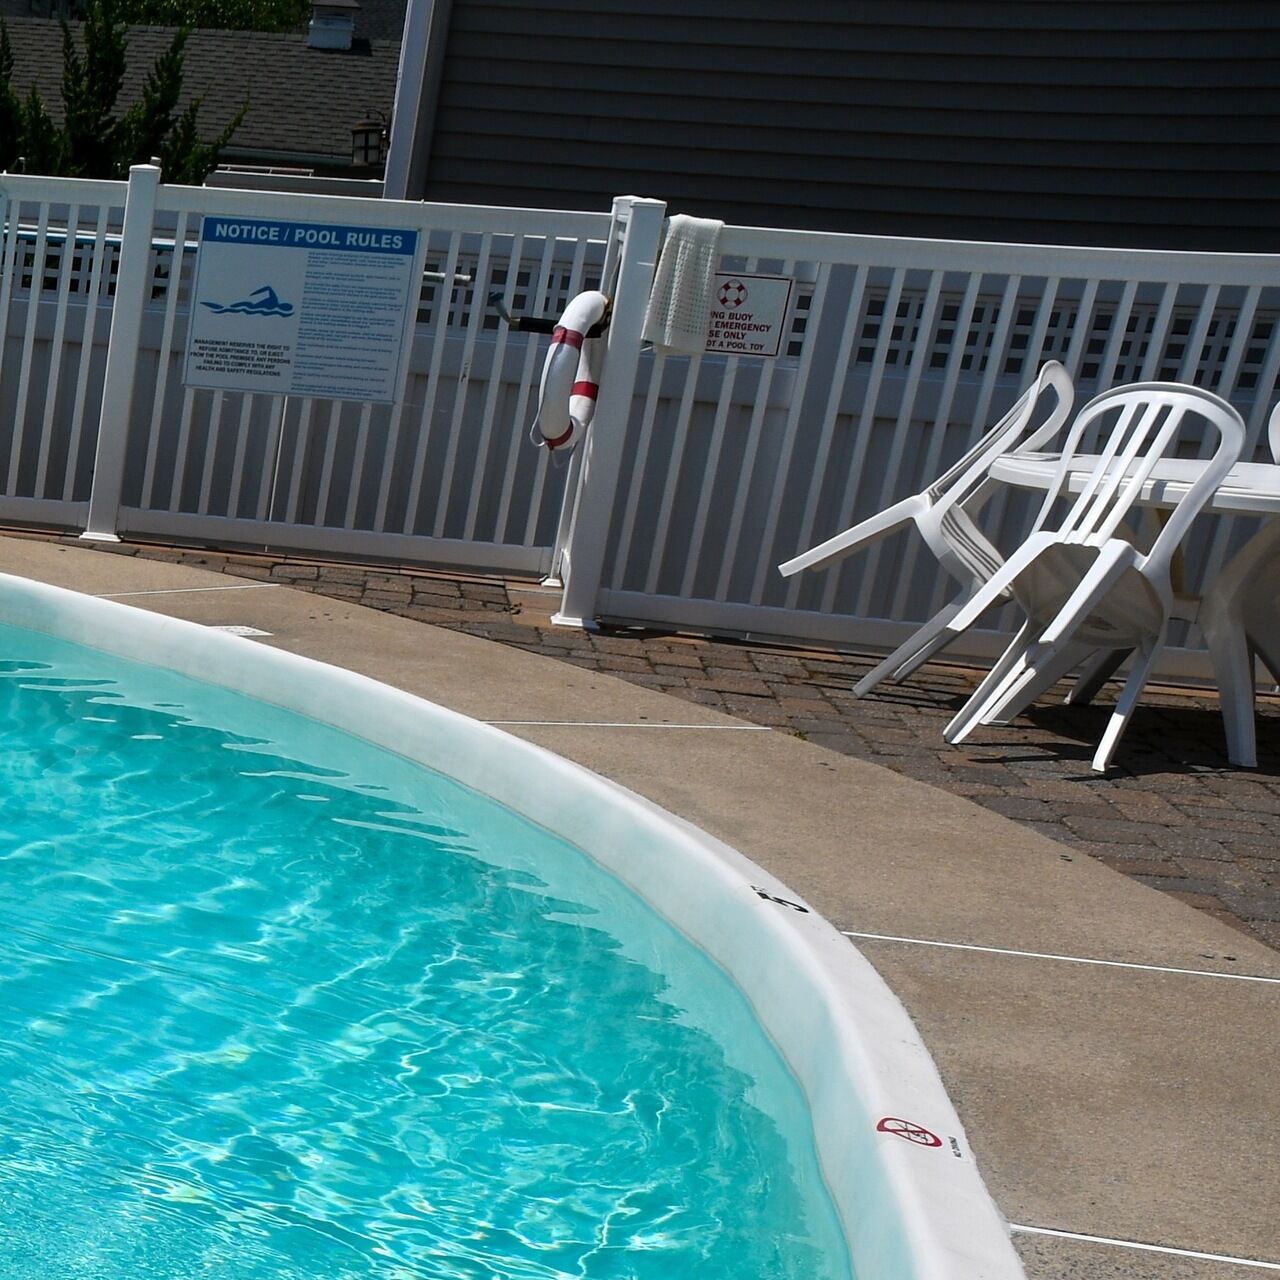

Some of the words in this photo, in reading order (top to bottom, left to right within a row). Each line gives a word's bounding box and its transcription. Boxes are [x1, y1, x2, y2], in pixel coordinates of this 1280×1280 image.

[216, 223, 280, 242] NOTICE
[284, 228, 290, 242] /
[294, 228, 340, 246] POOL
[346, 232, 403, 249] RULES
[728, 312, 754, 321] BUOY
[715, 321, 772, 332] EMERGENCY
[708, 330, 720, 338] SE
[724, 331, 746, 340] ONLY
[727, 342, 747, 350] POOL
[750, 343, 765, 351] TOY
